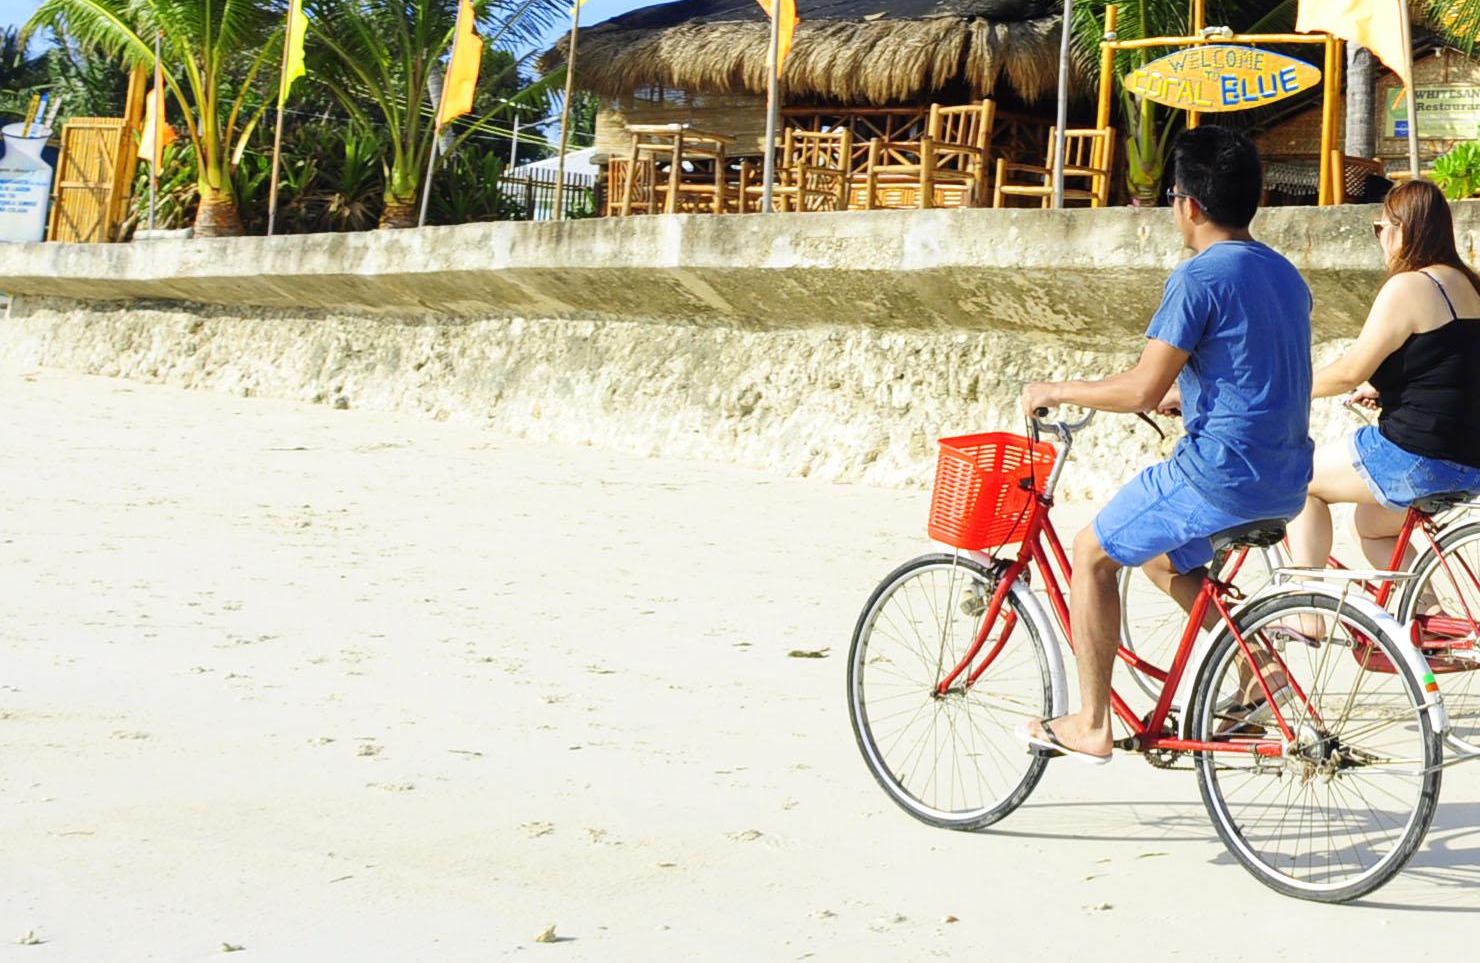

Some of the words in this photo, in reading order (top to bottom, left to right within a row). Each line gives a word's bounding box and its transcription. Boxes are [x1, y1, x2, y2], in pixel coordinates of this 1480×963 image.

[1168, 49, 1264, 72] WELCOME
[1205, 70, 1220, 81] TO
[1220, 65, 1299, 106] BLUE
